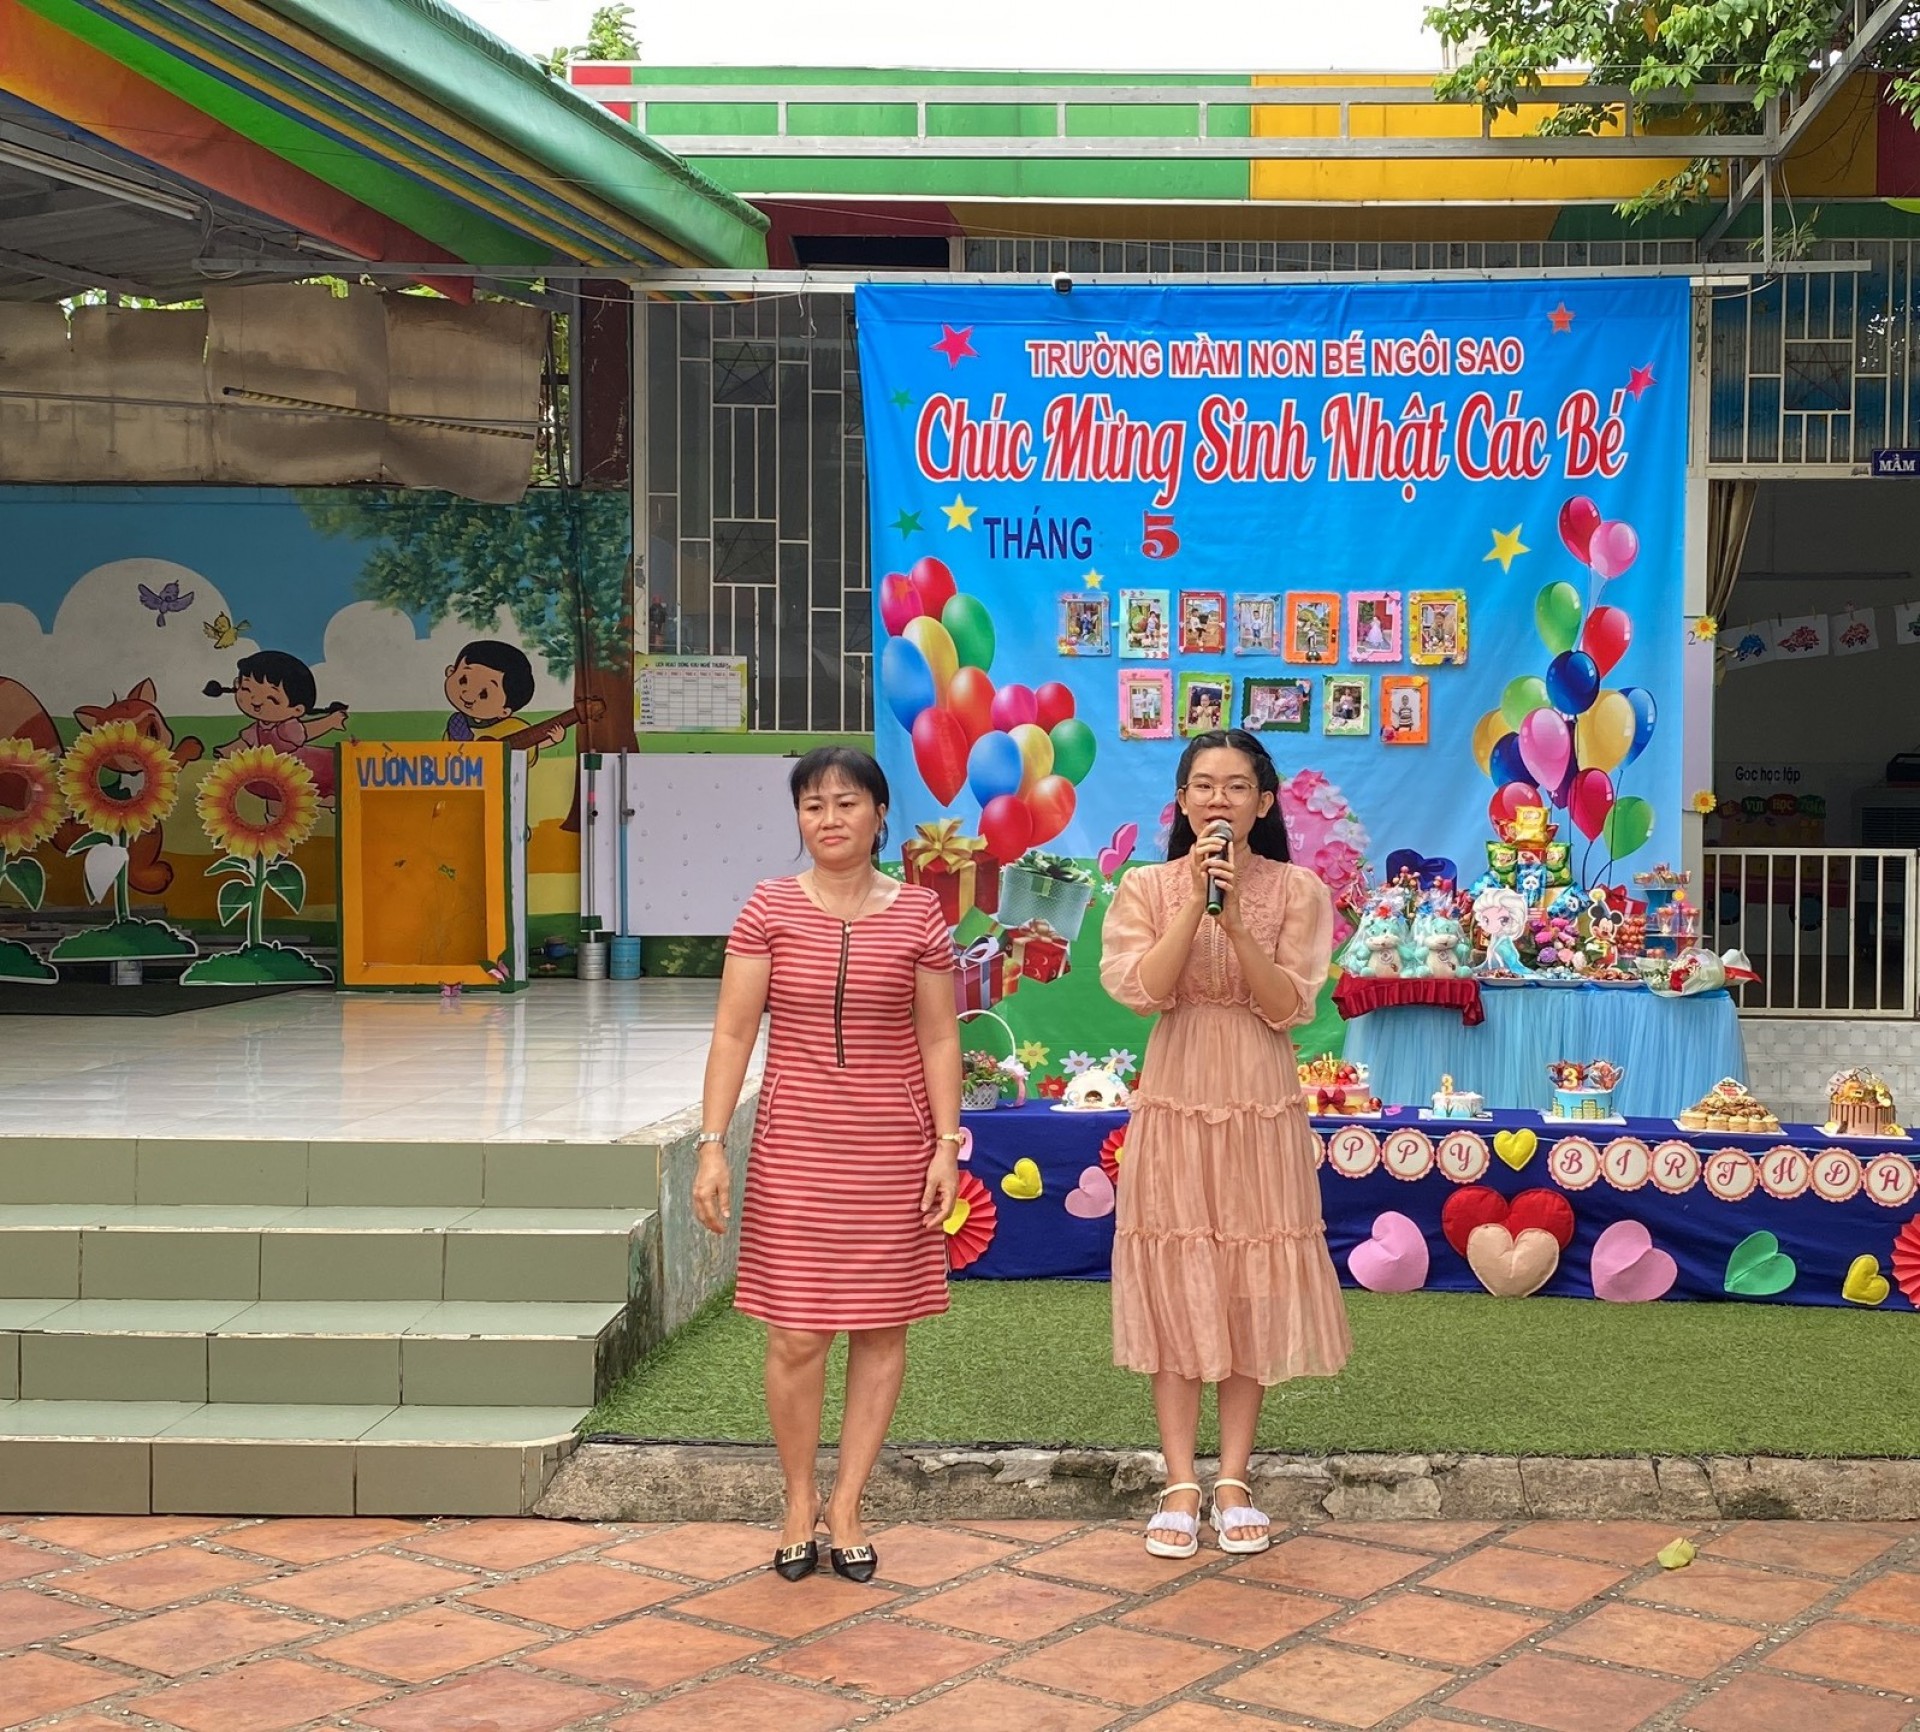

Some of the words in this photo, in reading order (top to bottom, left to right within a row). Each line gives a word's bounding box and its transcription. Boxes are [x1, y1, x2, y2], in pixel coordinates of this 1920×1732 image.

[1026, 332, 1162, 378] TRƯỜNG
[1169, 332, 1242, 378] MẦM
[1248, 340, 1316, 378] NON
[1323, 330, 1365, 376] BÉ
[1372, 329, 1450, 376] NGÔI
[1456, 336, 1524, 374] SAO
[915, 392, 1037, 482] Chúc
[1042, 393, 1186, 508] Mừng
[1193, 393, 1316, 484] Sinh
[1321, 392, 1450, 503] Nhật
[1455, 390, 1551, 481] Các
[1557, 387, 1628, 479] Bé
[983, 505, 1092, 560] THÁNG
[1141, 510, 1181, 560] 5
[1563, 1067, 1578, 1088] 3
[1343, 1136, 1471, 1171] PPY
[1560, 1148, 1905, 1193] BIRTHDA
